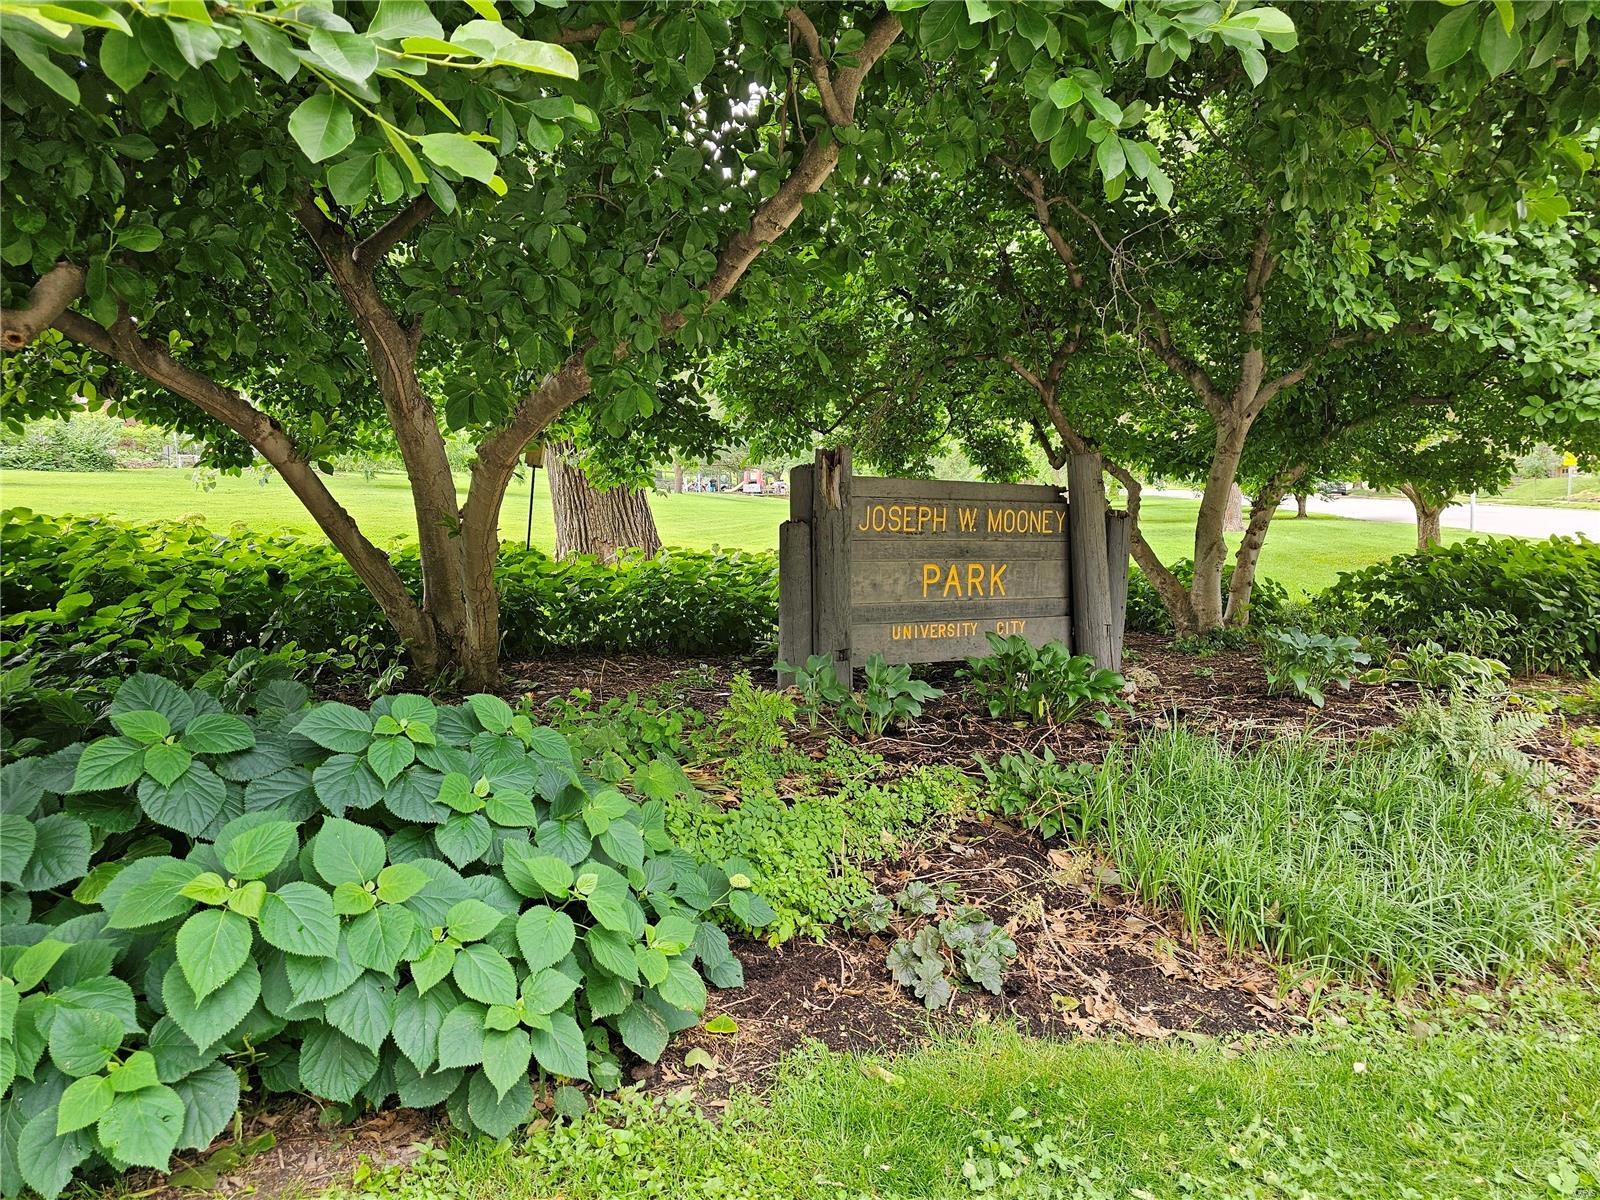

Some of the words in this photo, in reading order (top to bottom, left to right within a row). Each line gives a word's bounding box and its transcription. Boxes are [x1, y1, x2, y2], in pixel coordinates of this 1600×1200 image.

[858, 505, 947, 533] JOSEPH
[958, 507, 977, 532] W.
[987, 508, 1067, 534] MOONEY
[922, 562, 1008, 599] PARK
[892, 621, 978, 640] UNIVERSITY
[996, 620, 1026, 635] CITY
